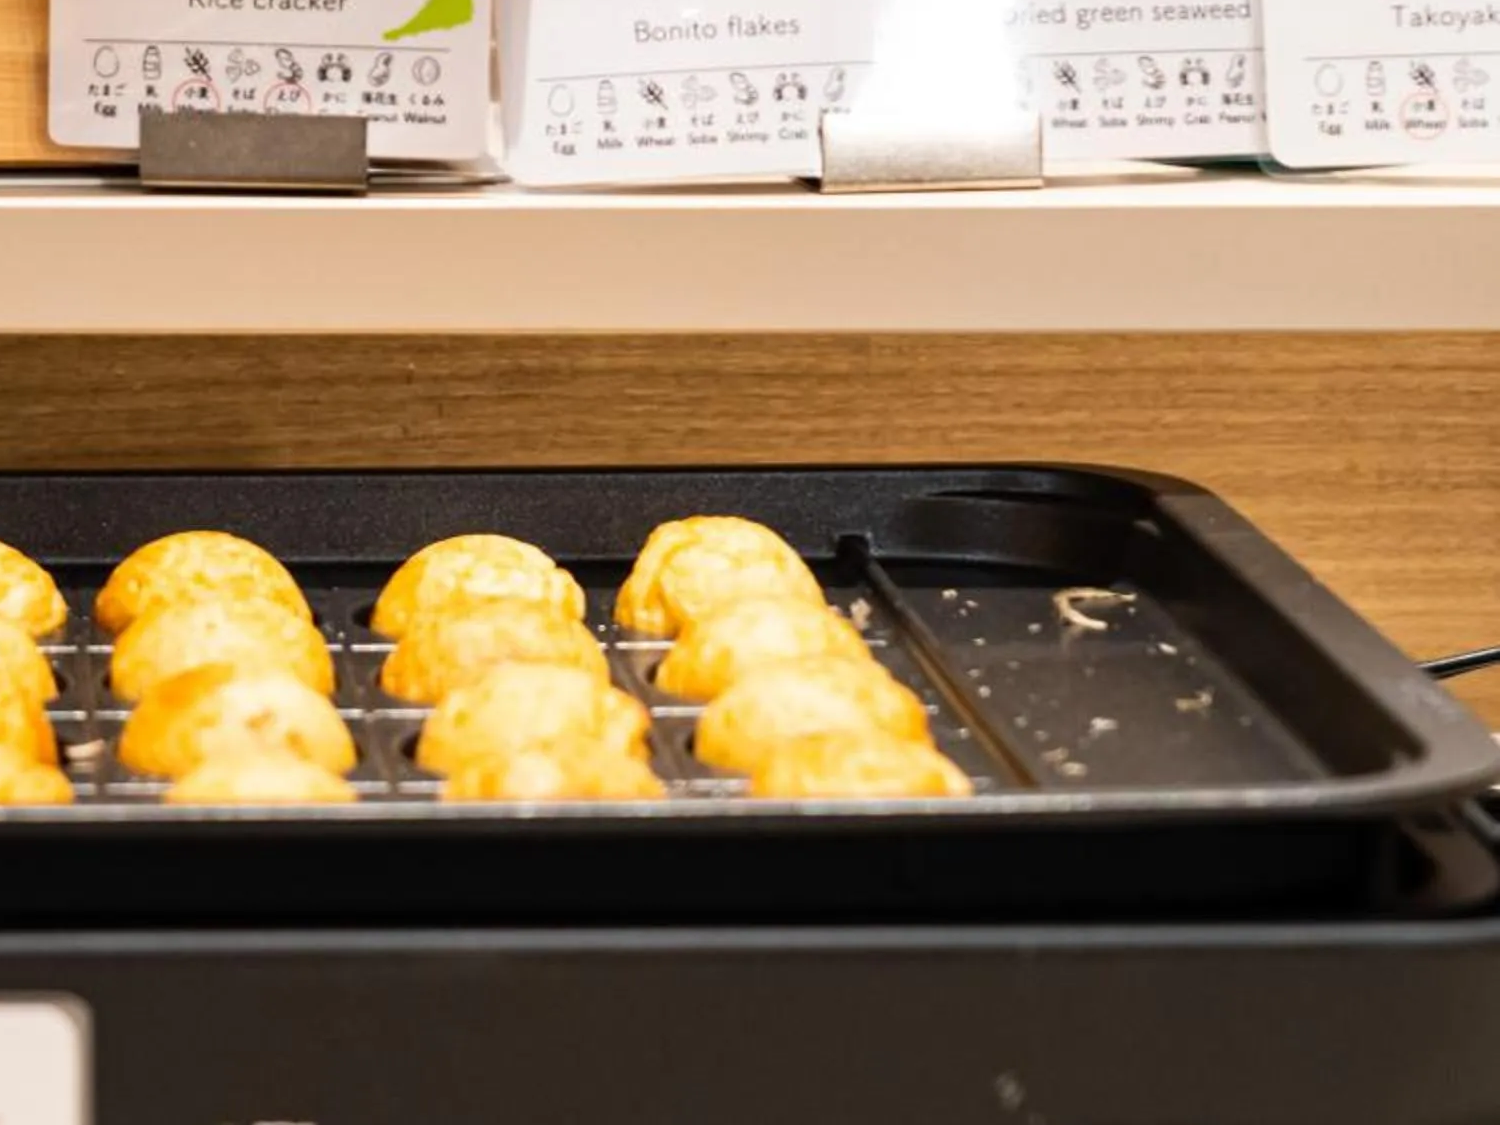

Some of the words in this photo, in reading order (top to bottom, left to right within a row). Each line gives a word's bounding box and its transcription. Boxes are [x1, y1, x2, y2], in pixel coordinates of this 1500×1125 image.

[633, 17, 718, 44] Bonito
[728, 13, 801, 37] flakes
[1075, 3, 1143, 31] green
